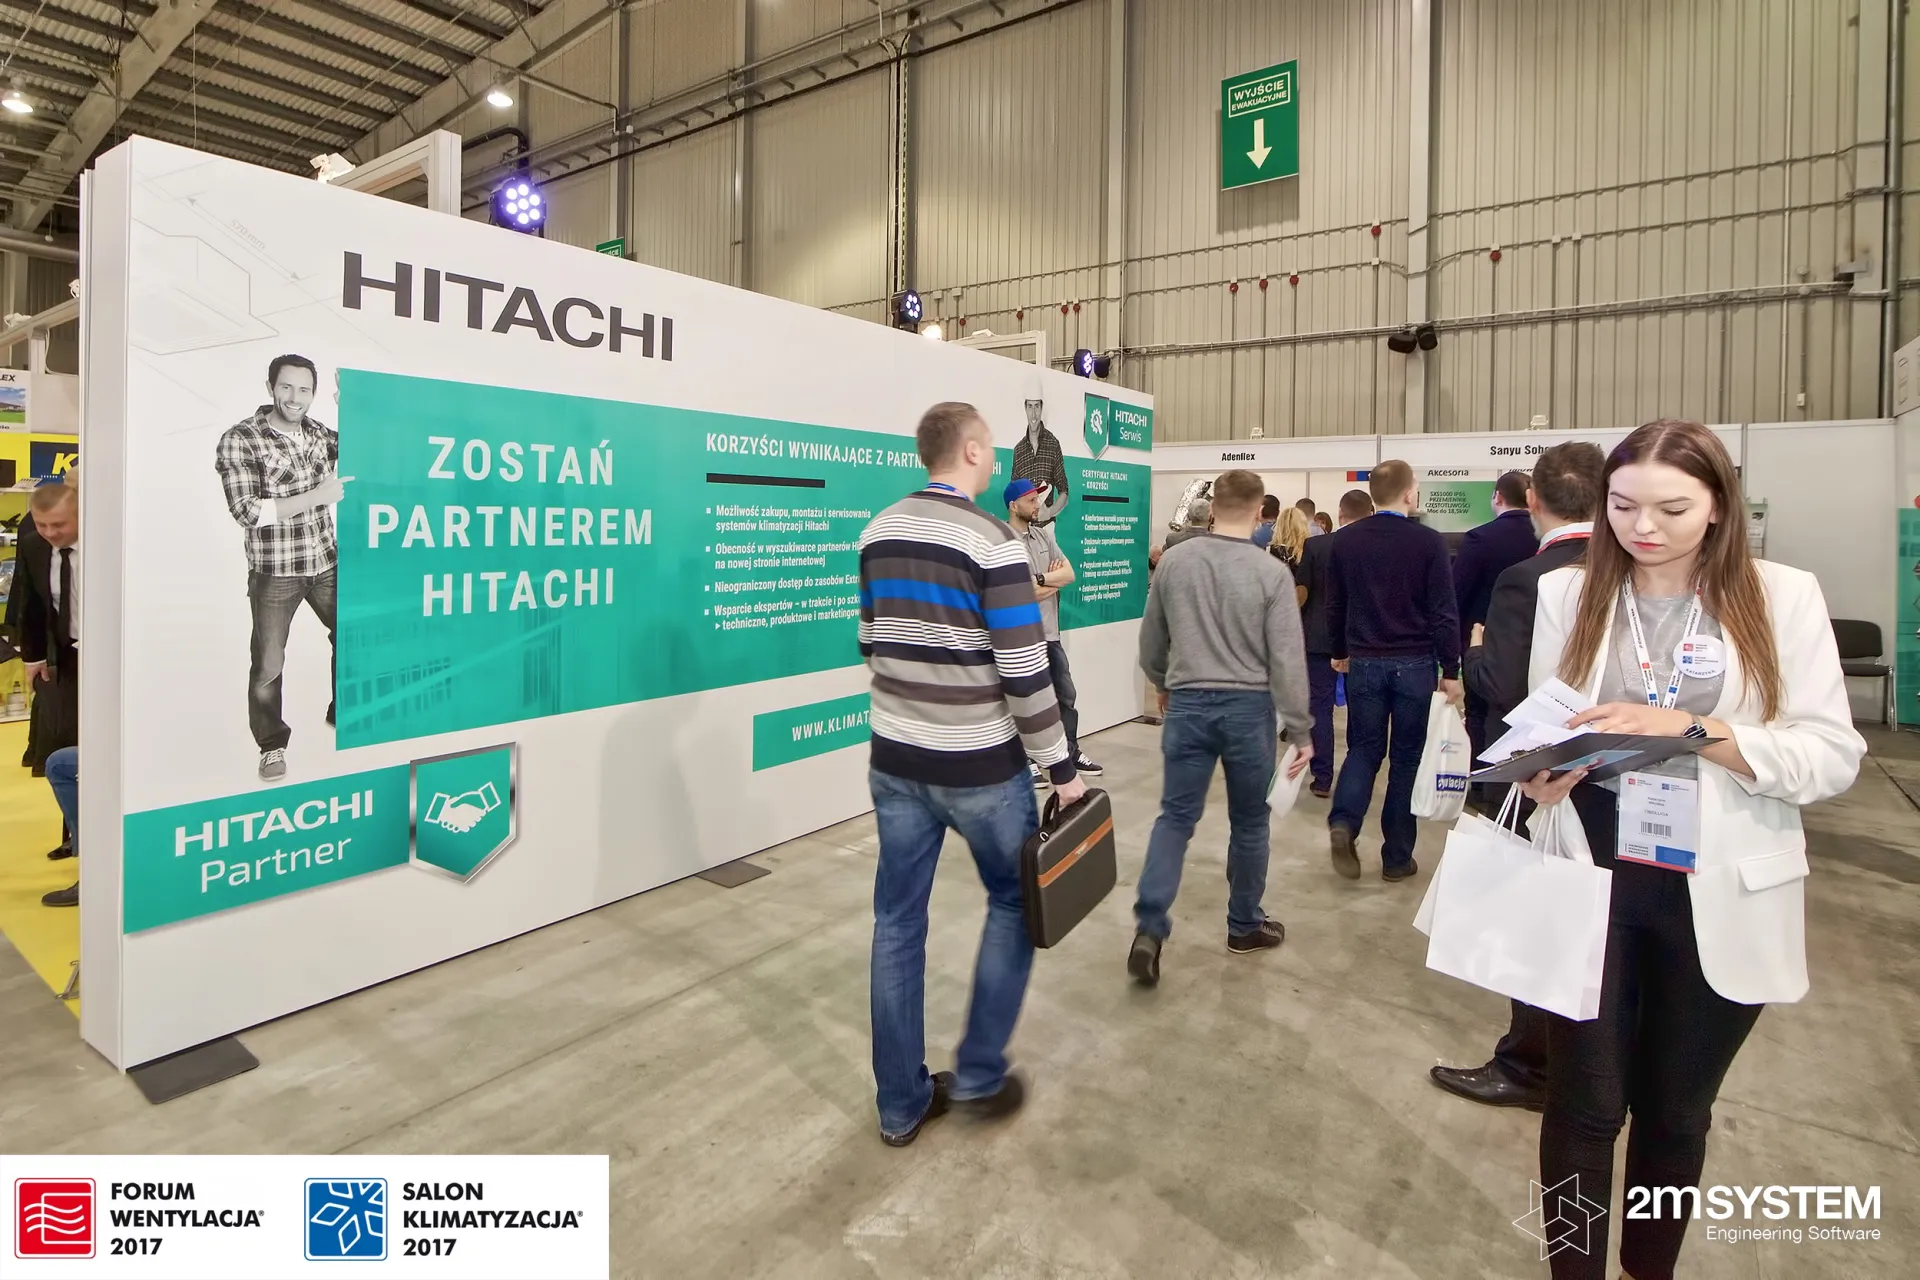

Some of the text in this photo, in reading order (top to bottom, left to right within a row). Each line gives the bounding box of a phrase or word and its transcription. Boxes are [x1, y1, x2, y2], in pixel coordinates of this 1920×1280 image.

[1231, 90, 1287, 111] EWAKUACYJNE
[1234, 80, 1284, 101] WYJŚCIE
[343, 251, 673, 361] HITACHI
[1115, 409, 1147, 427] HITACHI
[1120, 427, 1142, 443] Serwis
[428, 436, 613, 485] ZOSTAŃ
[706, 433, 783, 457] KORZYŚCI
[789, 441, 873, 467] WYNIKAJĄCE
[876, 452, 883, 466] Z
[887, 450, 926, 469] PARTN
[1490, 446, 1521, 456] Sanyu
[1082, 469, 1128, 481] CERTYFIKAT HITACHI
[1086, 481, 1109, 490] KORZYŚCI
[716, 505, 871, 519] Możliwość zakupu, montażu i serwisowania
[368, 504, 652, 548] PARTNEREM
[715, 520, 830, 534] systemów klimatyzacji Hitachi
[715, 542, 756, 555] Obecność
[757, 544, 764, 553] w
[765, 542, 816, 556] wyszukiwarce
[817, 541, 851, 554] partnerów
[715, 554, 826, 571] na nowej stronie internetowej
[423, 568, 613, 616] HITACHI
[714, 579, 777, 594] Nieograniczony
[778, 577, 803, 590] dostęp
[804, 576, 814, 587] do
[815, 574, 844, 586] zasobów
[714, 602, 752, 618] Wsparcie
[753, 599, 793, 614] ekspertów
[801, 600, 807, 609] w
[808, 596, 833, 608] trakcie
[833, 595, 836, 605] i
[837, 596, 846, 607] po
[722, 607, 861, 630] techniczne, produktowe i marketingow
[792, 709, 872, 741] WWW.KLIMAT
[175, 789, 373, 857] HITACHI
[201, 837, 352, 894] Partner
